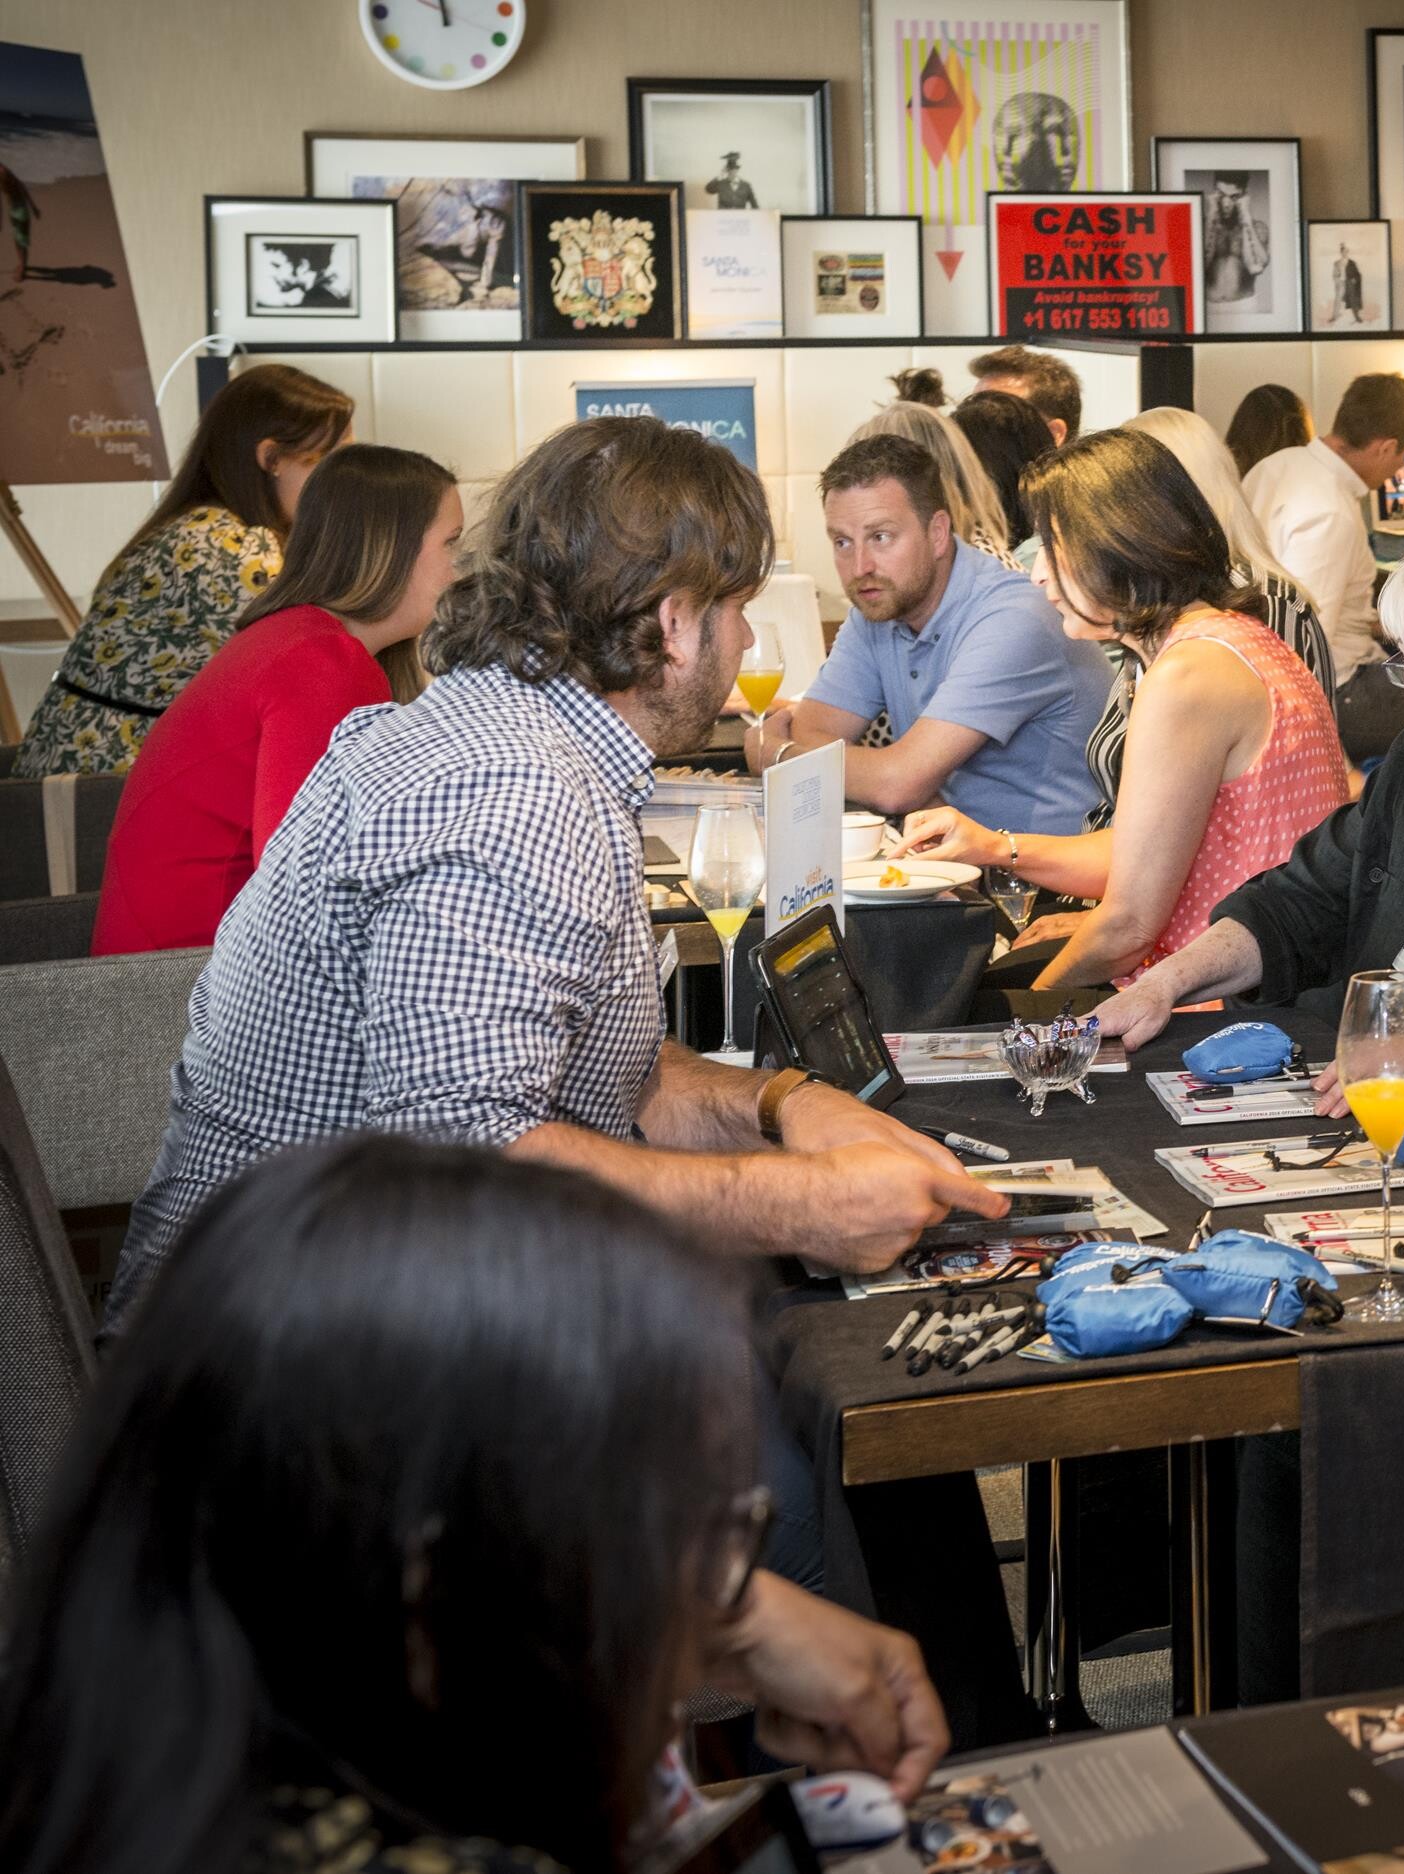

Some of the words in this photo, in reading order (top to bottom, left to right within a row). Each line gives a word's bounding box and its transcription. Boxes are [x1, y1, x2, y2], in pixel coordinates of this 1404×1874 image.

[1064, 239, 1085, 249] for
[1093, 240, 1126, 251] your
[1024, 254, 1167, 281] BANKSY
[1034, 292, 1074, 304] Avoid
[1079, 292, 1160, 305] bankruptcy!
[1024, 310, 1044, 329] +1
[1050, 310, 1083, 329] 617
[1127, 308, 1170, 329] 1103
[586, 403, 655, 418] SANTA
[665, 420, 746, 439] ONICA
[805, 864, 822, 886] visit
[779, 875, 835, 919] California
